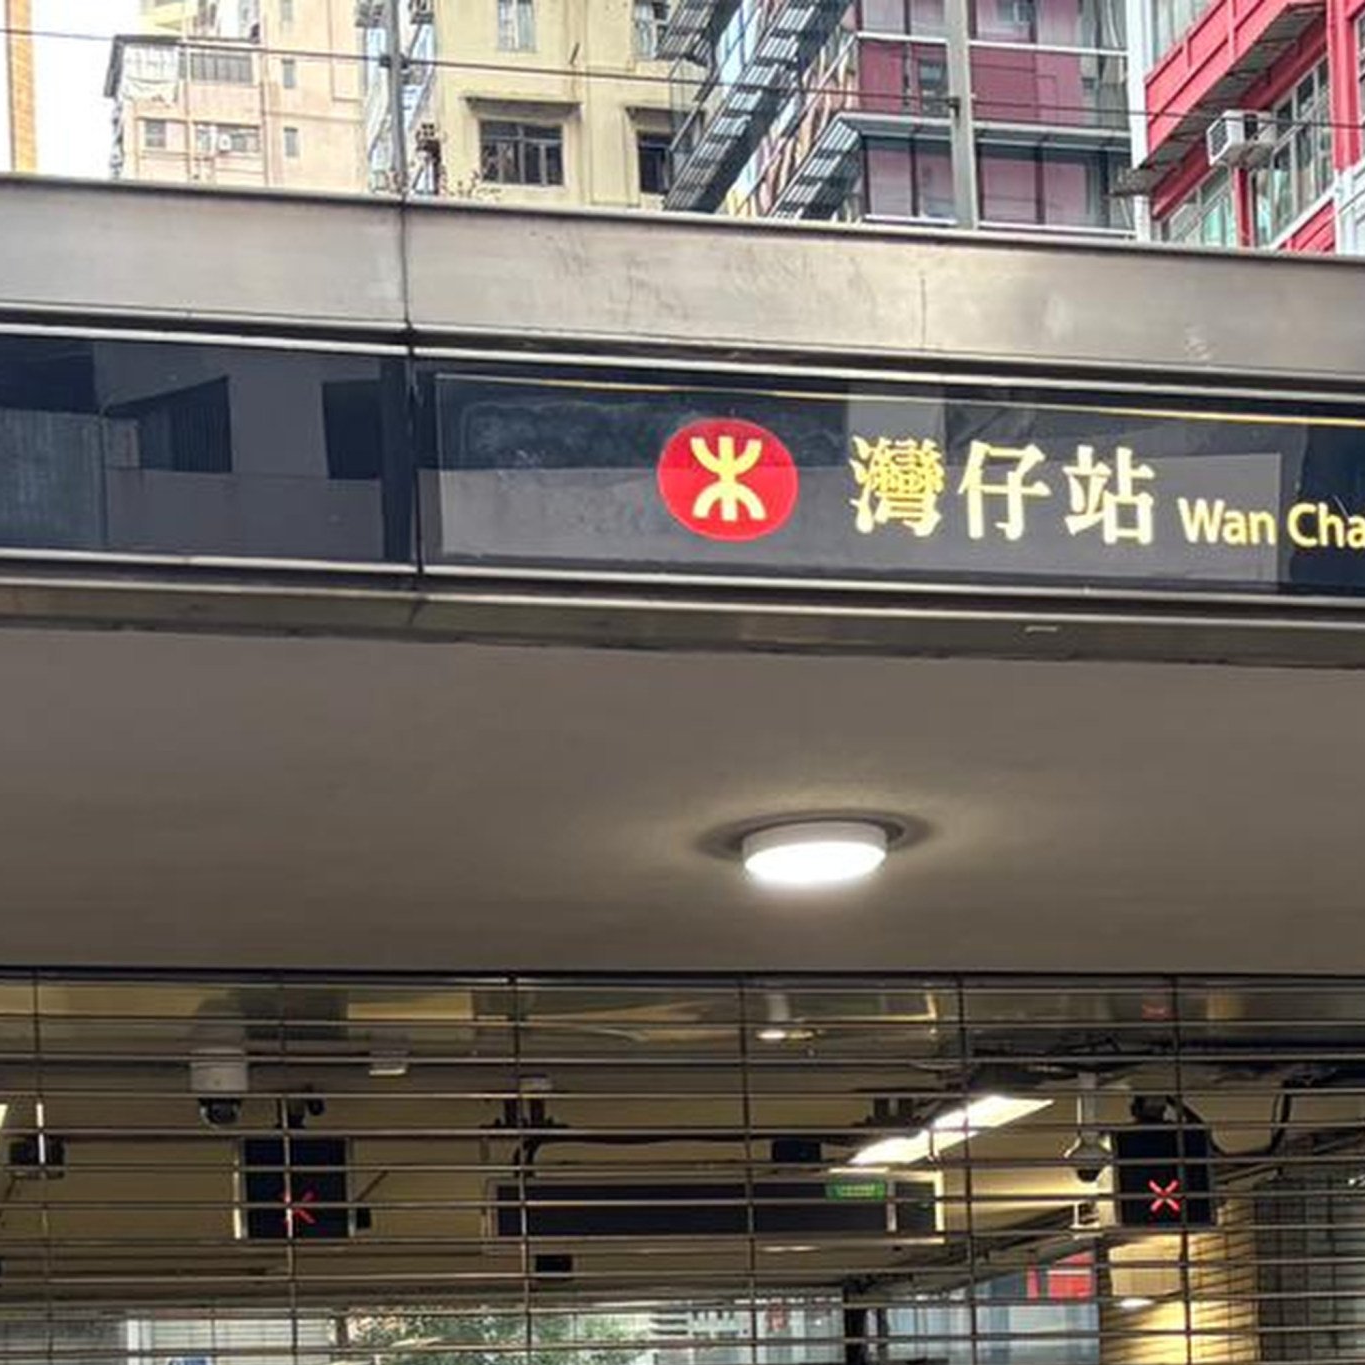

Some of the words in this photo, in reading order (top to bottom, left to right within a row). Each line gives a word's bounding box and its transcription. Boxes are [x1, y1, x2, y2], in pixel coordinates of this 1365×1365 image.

[848, 434, 1155, 546] 灣仔站
[1178, 496, 1278, 544] Wan
